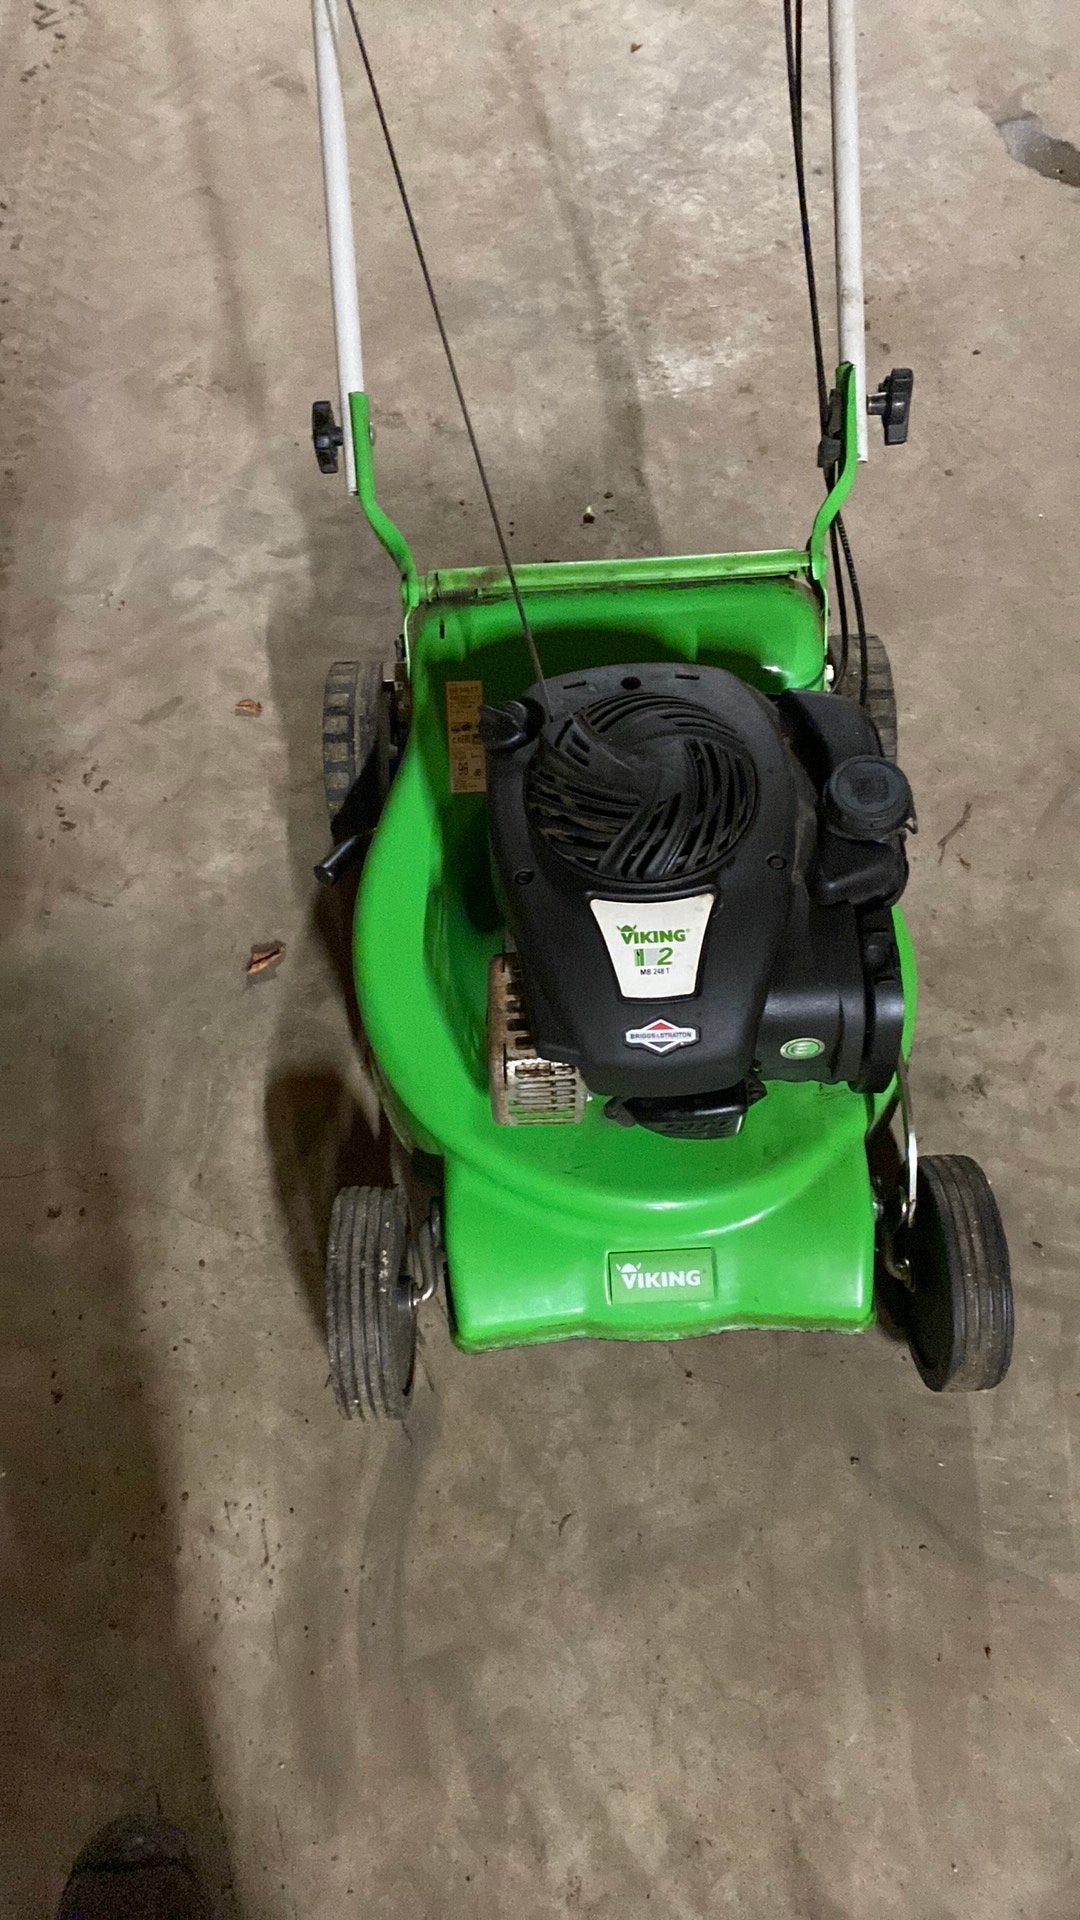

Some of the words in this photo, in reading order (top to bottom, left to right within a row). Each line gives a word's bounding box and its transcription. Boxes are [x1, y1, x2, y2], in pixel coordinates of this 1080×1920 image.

[621, 929, 686, 945] VIKING
[657, 947, 673, 966] 2
[640, 968, 652, 976] MB
[621, 1269, 701, 1290] VIKING
